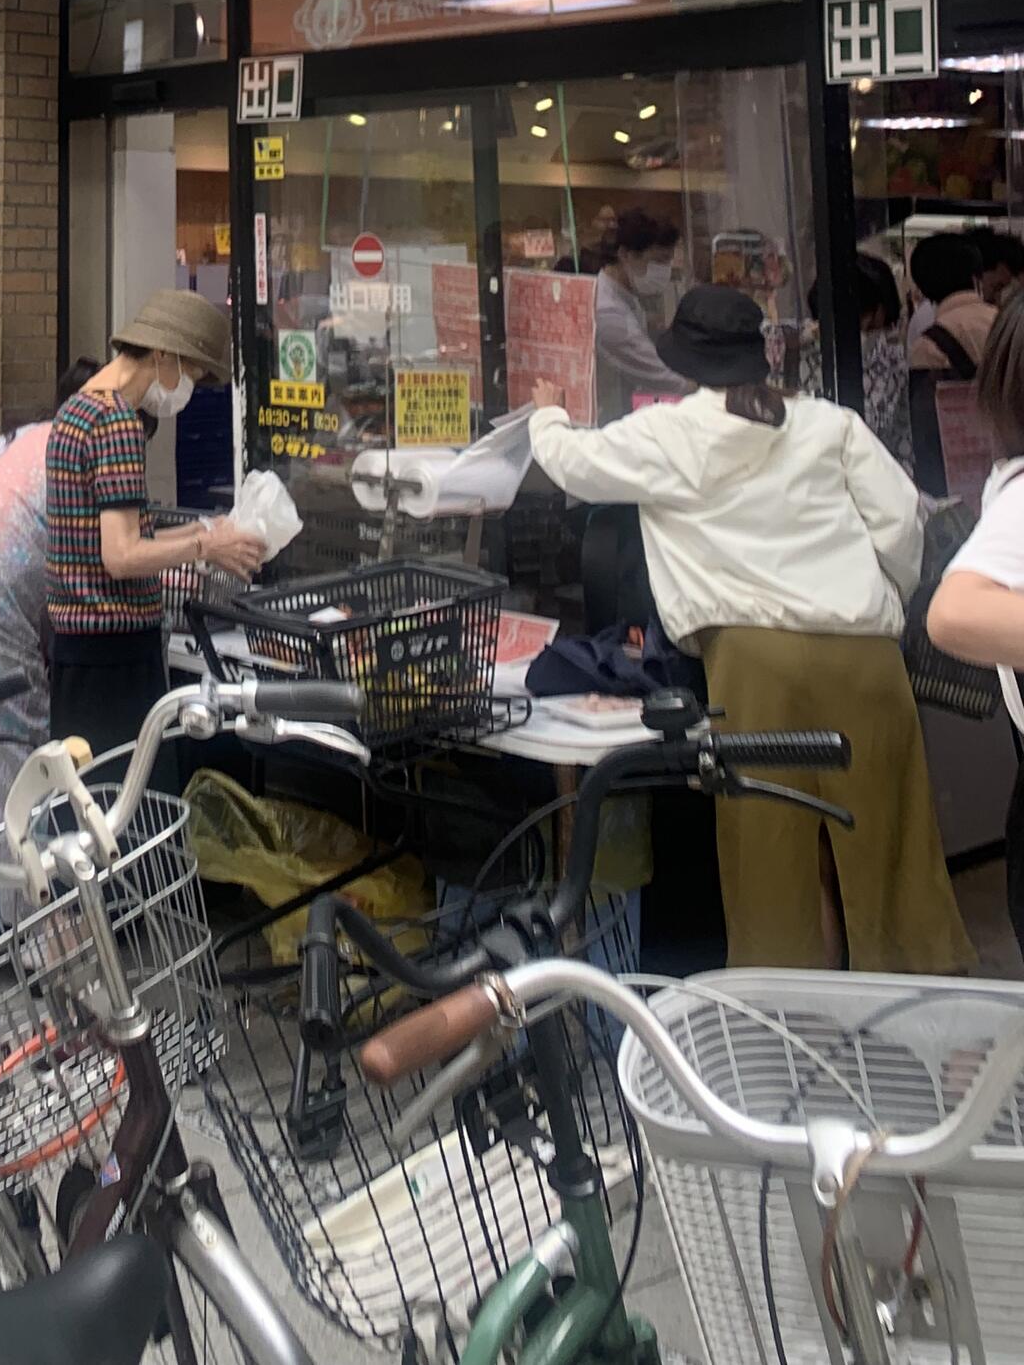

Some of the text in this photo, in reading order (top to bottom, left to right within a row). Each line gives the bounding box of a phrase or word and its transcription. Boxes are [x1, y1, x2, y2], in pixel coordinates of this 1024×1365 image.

[241, 58, 297, 119] 出口
[329, 283, 412, 313] 出口専用
[273, 385, 321, 403] 営業案内
